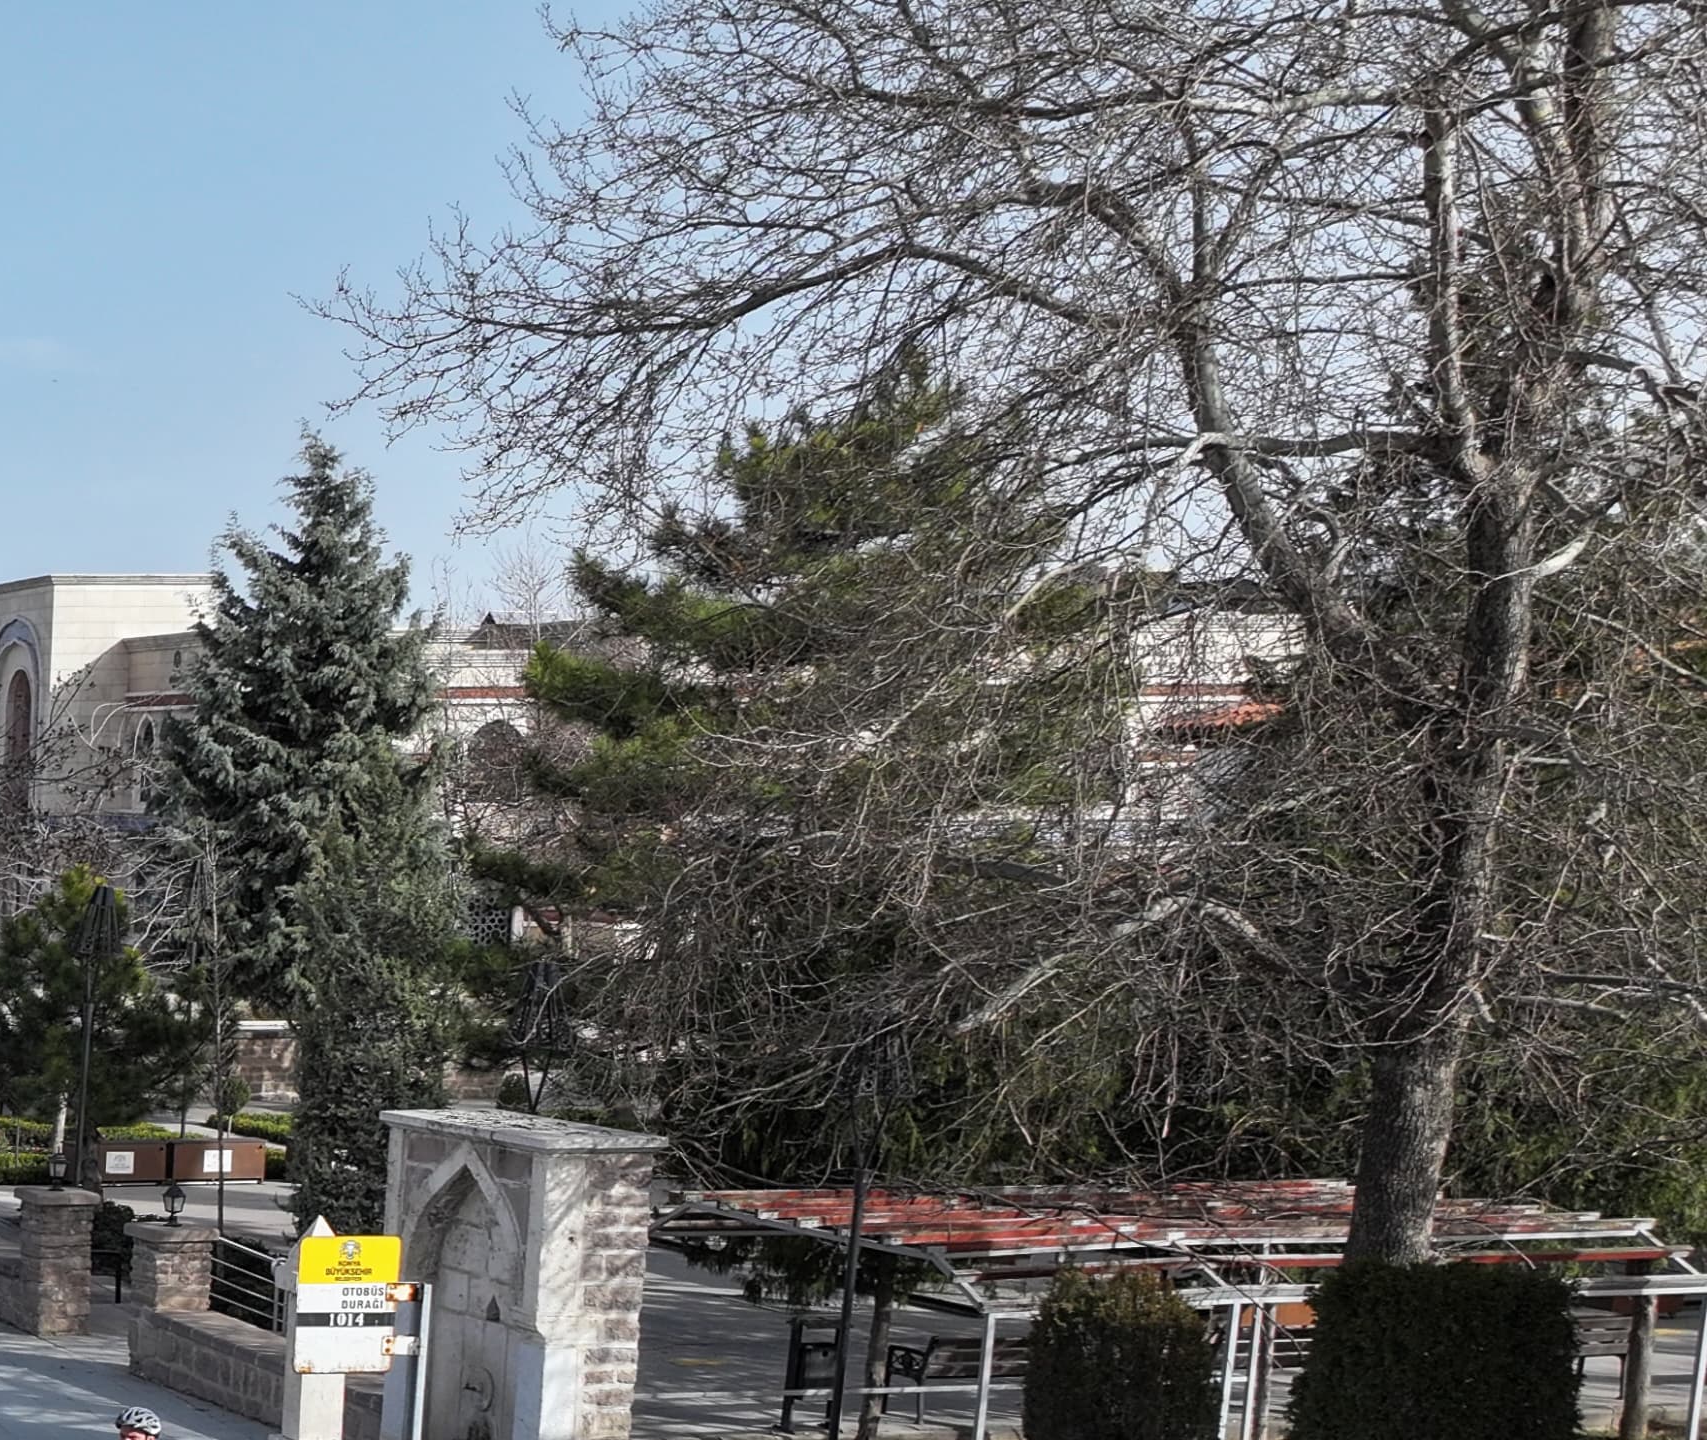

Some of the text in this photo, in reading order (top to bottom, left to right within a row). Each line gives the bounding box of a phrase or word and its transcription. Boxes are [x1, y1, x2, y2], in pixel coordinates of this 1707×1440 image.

[342, 1286, 385, 1296] OTOBÜS
[341, 1299, 384, 1309] DURAĞI
[329, 1313, 364, 1327] 1014
